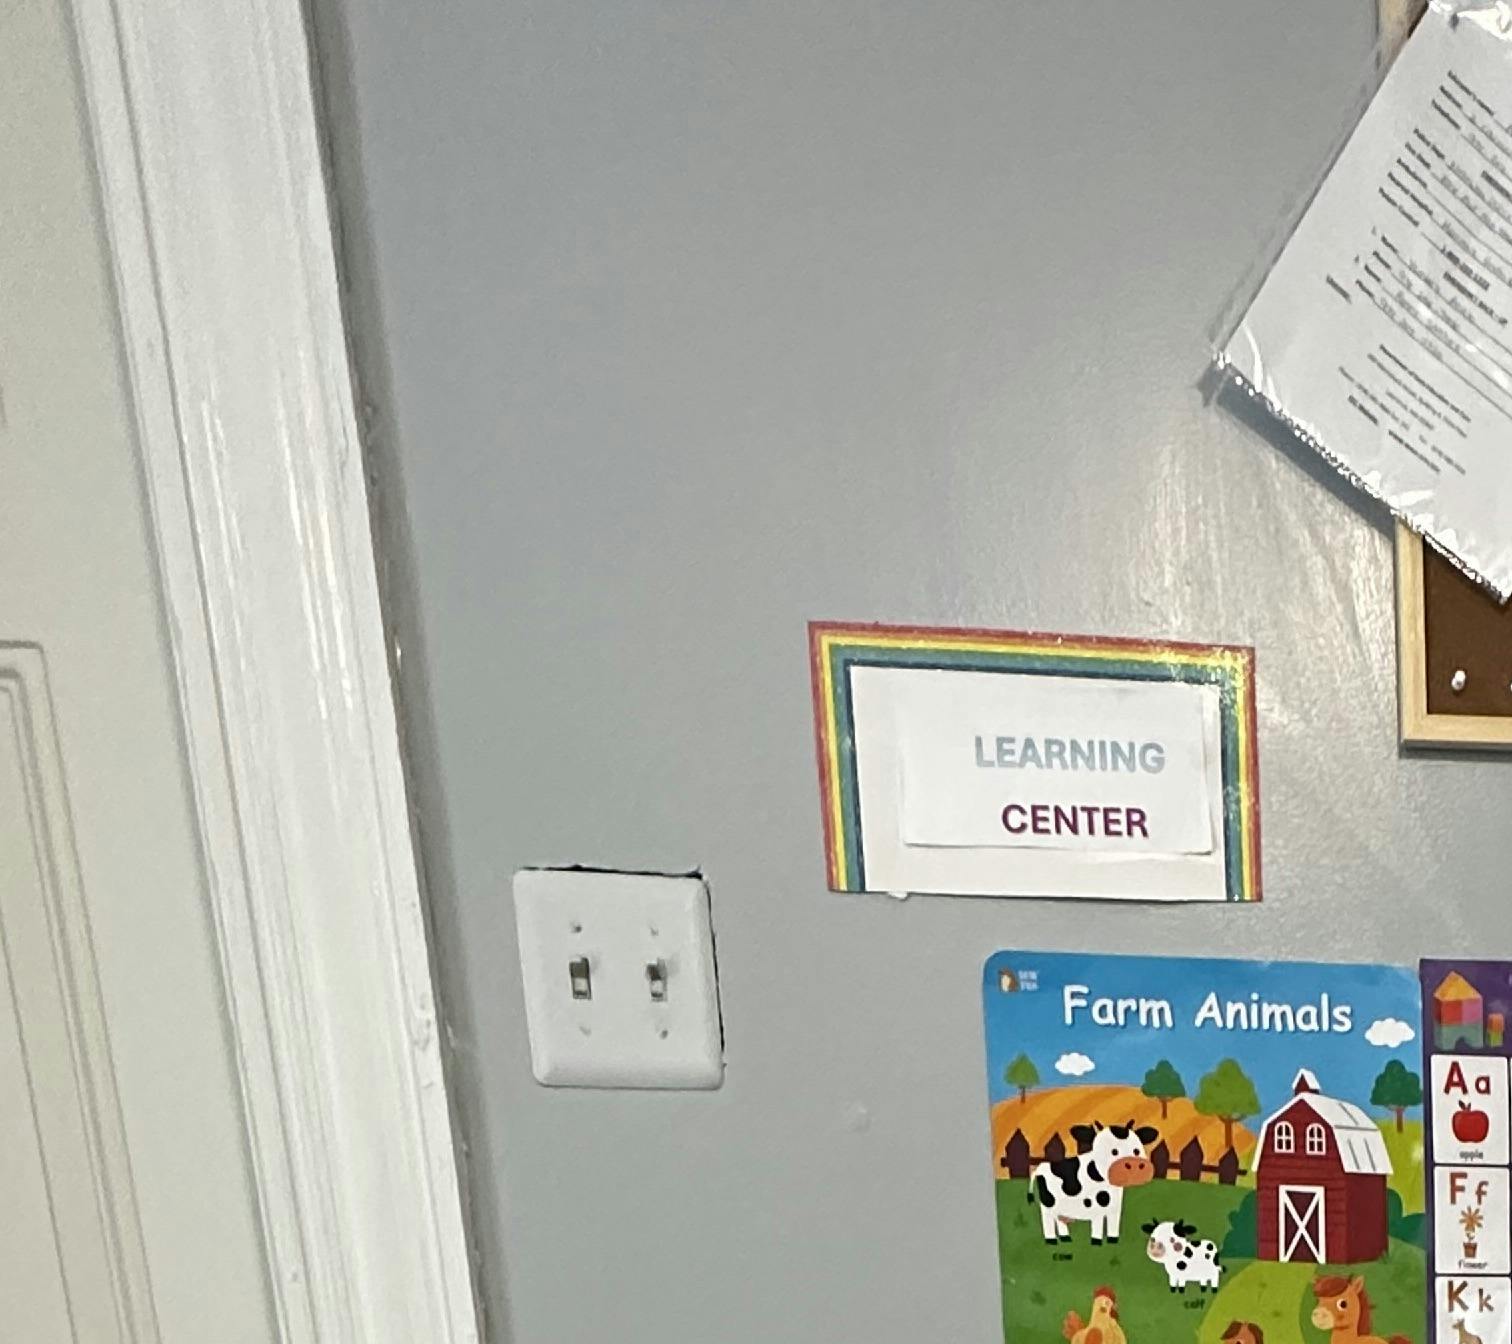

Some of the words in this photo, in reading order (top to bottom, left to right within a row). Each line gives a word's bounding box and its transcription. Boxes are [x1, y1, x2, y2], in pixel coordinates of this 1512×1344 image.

[975, 735, 1166, 774] LEARNING
[1001, 803, 1149, 838] CENTER
[1062, 984, 1175, 1029] Farm
[1194, 992, 1353, 1033] Animals
[1444, 1062, 1491, 1095] Aa
[1449, 1172, 1489, 1205] Ff
[1447, 1280, 1493, 1313] Kk
